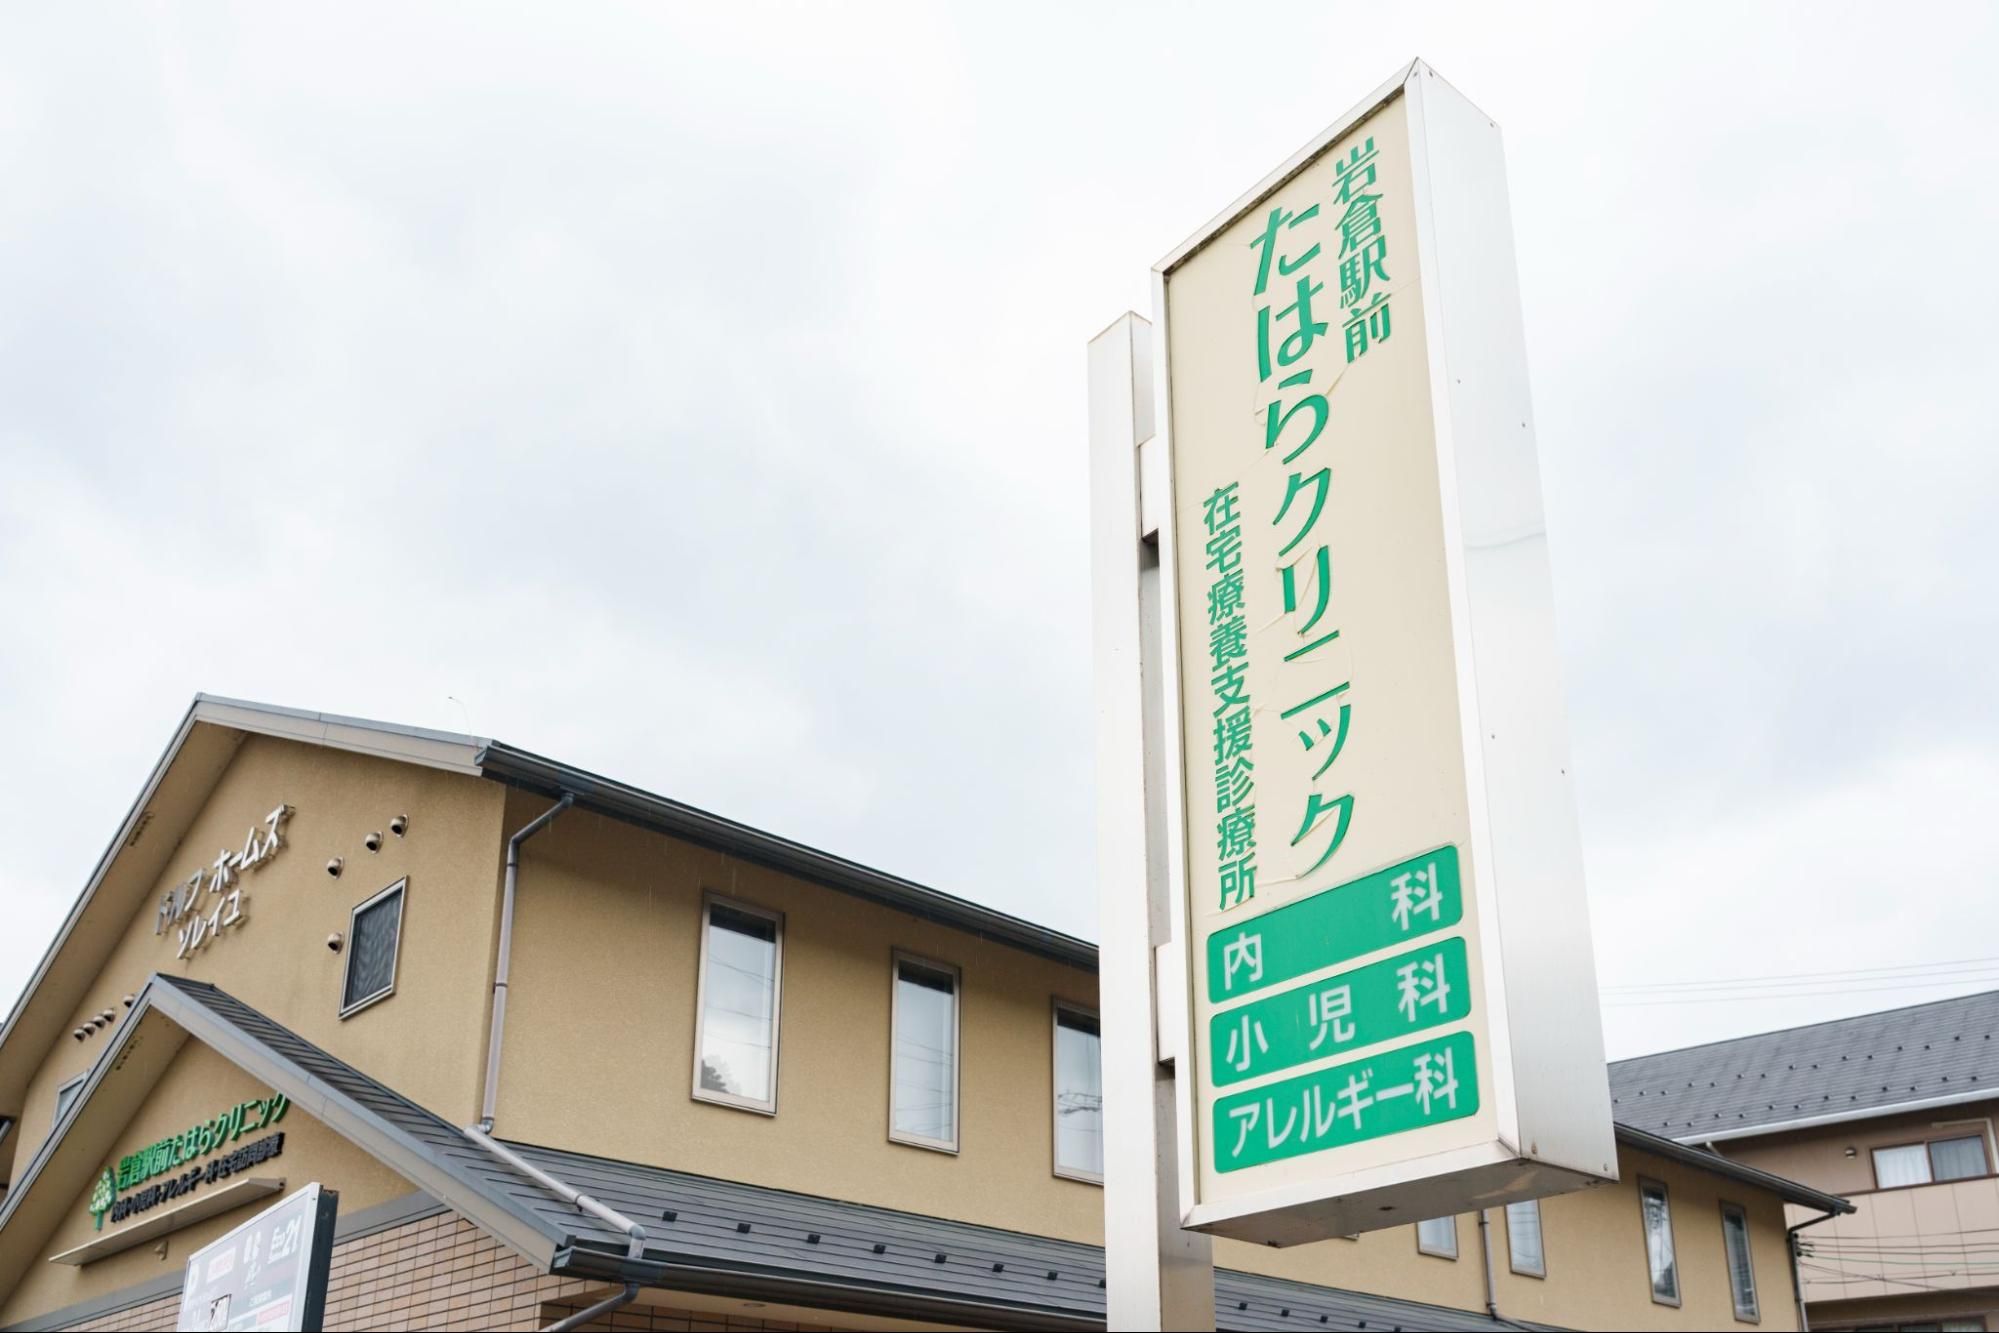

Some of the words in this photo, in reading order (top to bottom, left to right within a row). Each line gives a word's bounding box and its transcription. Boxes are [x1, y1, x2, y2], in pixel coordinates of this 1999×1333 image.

[1332, 136, 1391, 364] 岩倉駅前
[1250, 203, 1354, 881] たはらクリニック
[1203, 481, 1257, 911] 在宅療養支援診療所
[1223, 862, 1443, 991] 内科
[1226, 953, 1450, 1073] 小児科
[1228, 1047, 1459, 1158] アレルギー科
